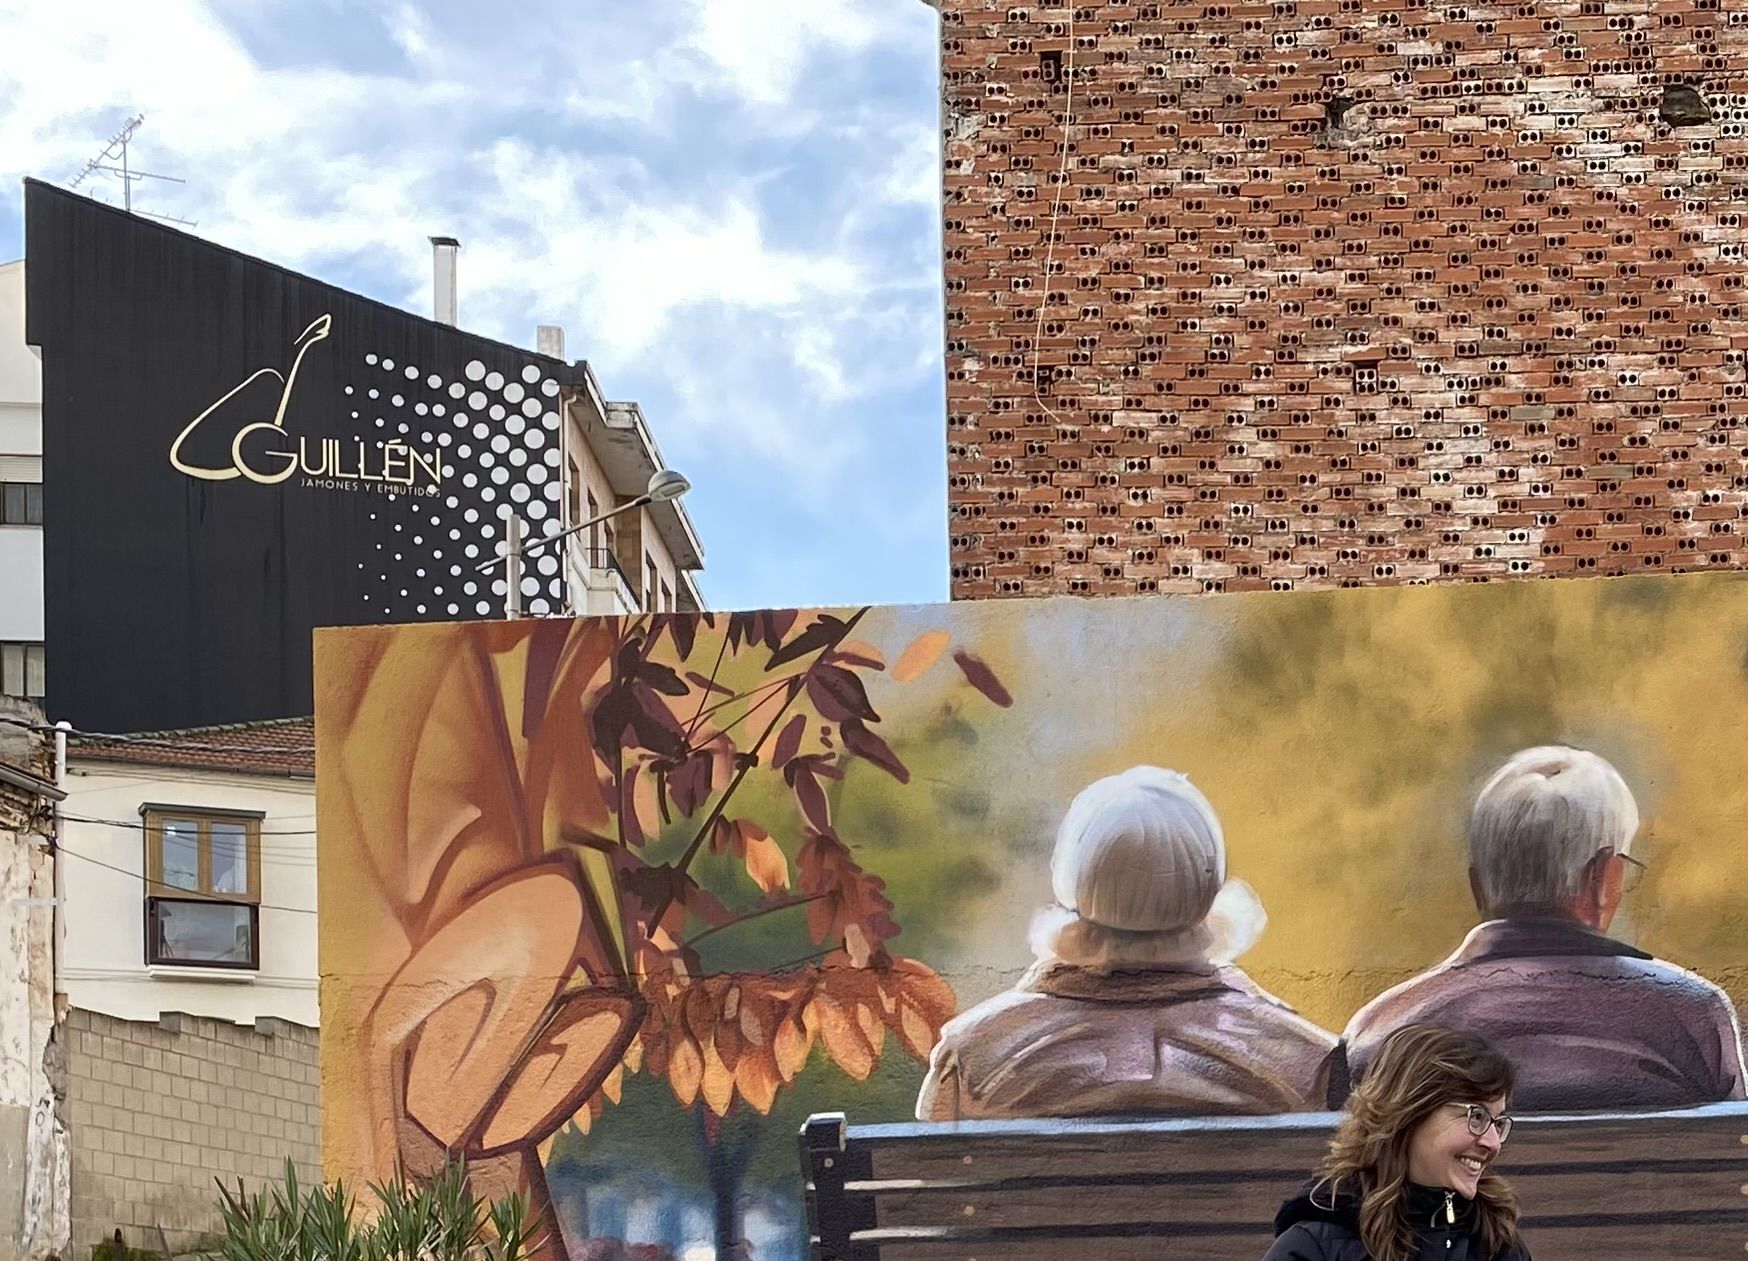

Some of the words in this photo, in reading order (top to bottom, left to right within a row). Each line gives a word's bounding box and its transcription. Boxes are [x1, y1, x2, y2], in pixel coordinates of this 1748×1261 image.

[232, 422, 441, 484] GUILLÉN
[300, 478, 358, 492] JAMONES
[364, 482, 371, 492] Y
[377, 483, 441, 498] EMBUTIDOS
